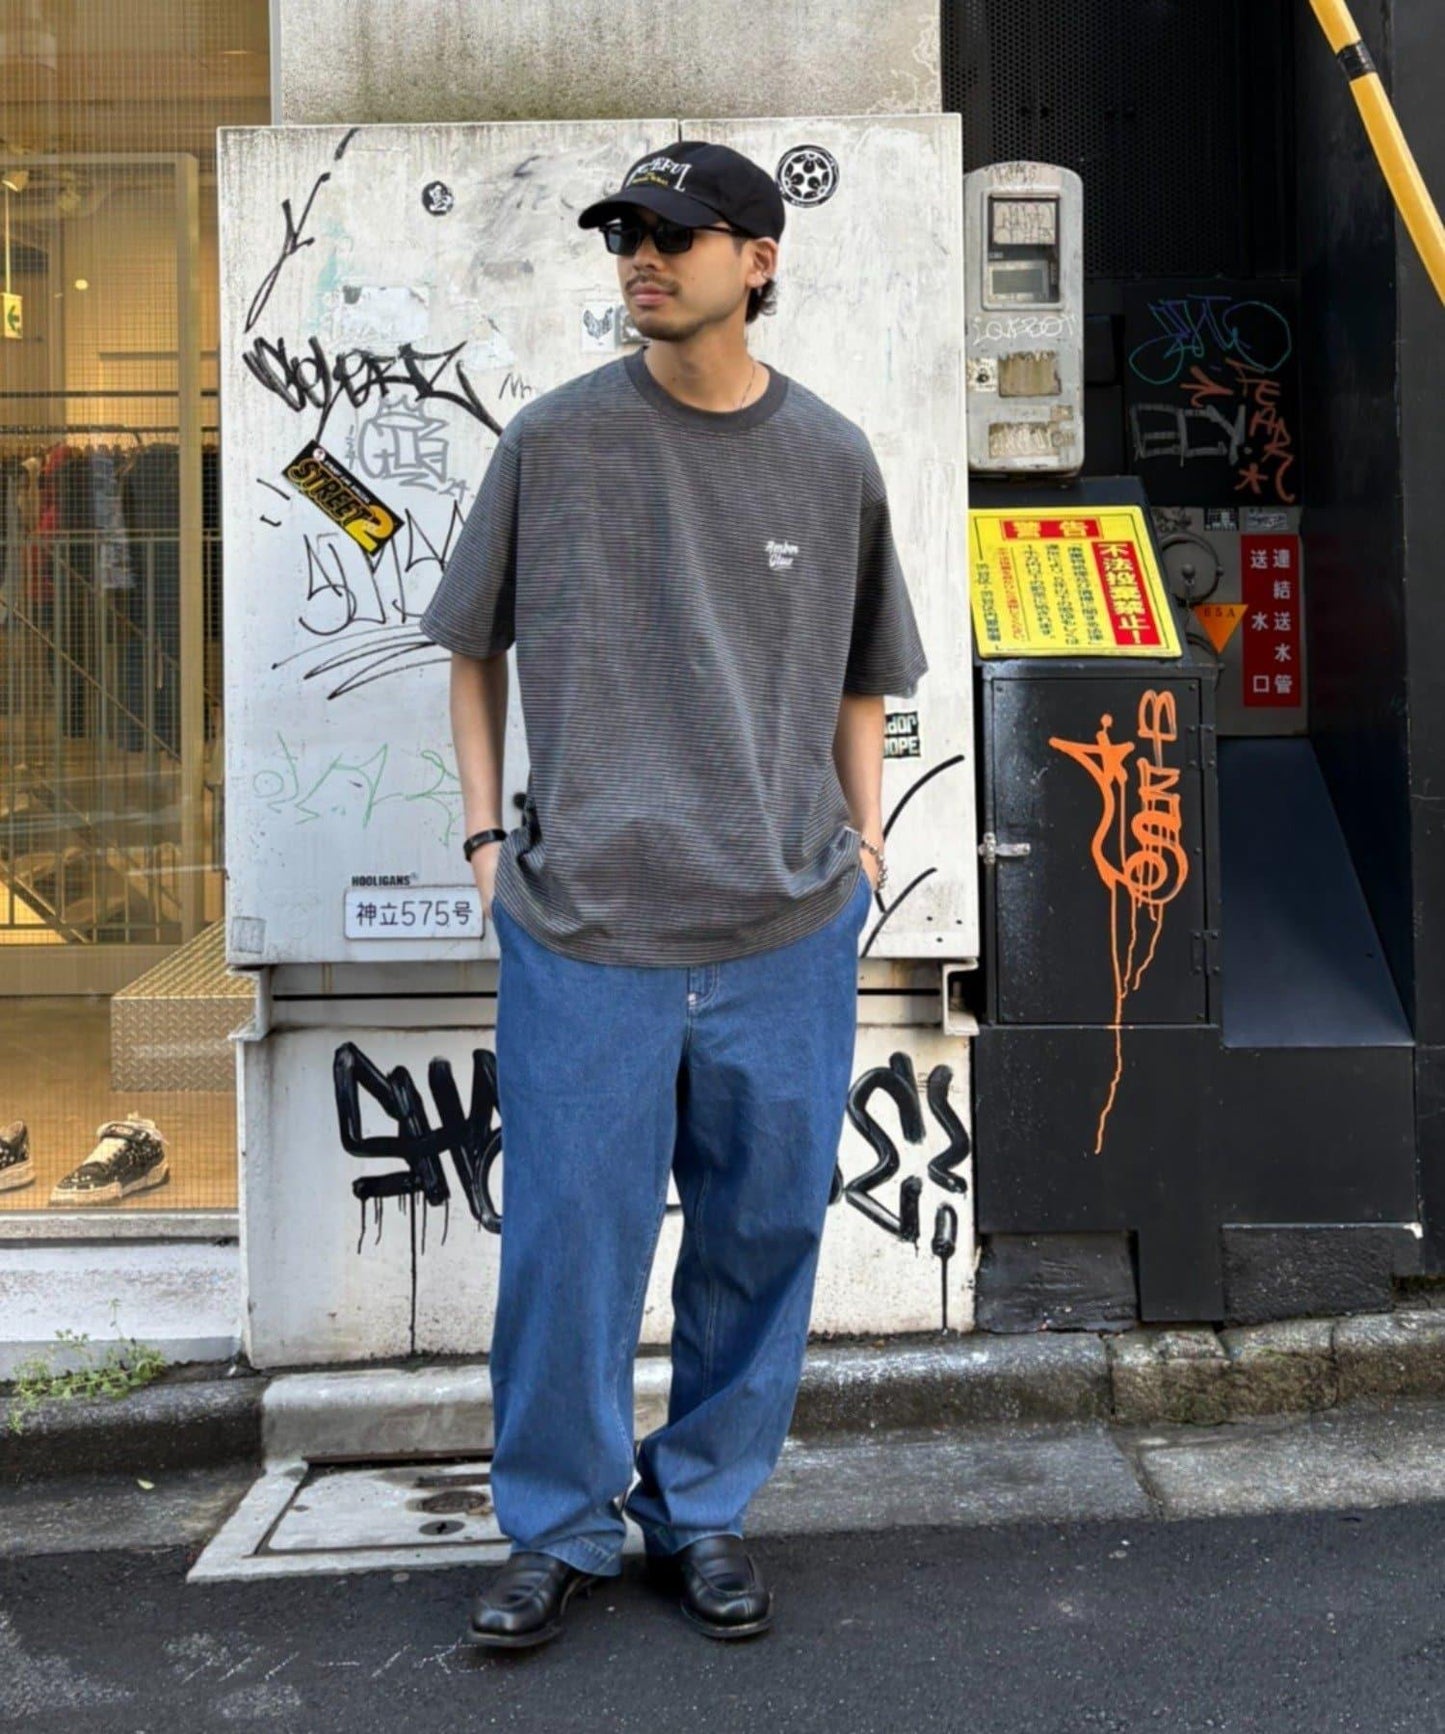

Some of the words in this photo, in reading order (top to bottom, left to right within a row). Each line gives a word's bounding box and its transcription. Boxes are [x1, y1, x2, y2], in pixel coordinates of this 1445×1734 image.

[1011, 520, 1088, 537] 警告
[1250, 549, 1269, 692] 送水口
[1272, 548, 1292, 694] 連結送水管
[352, 875, 410, 886] HOOLIGANS
[356, 900, 472, 927] 神立575号
